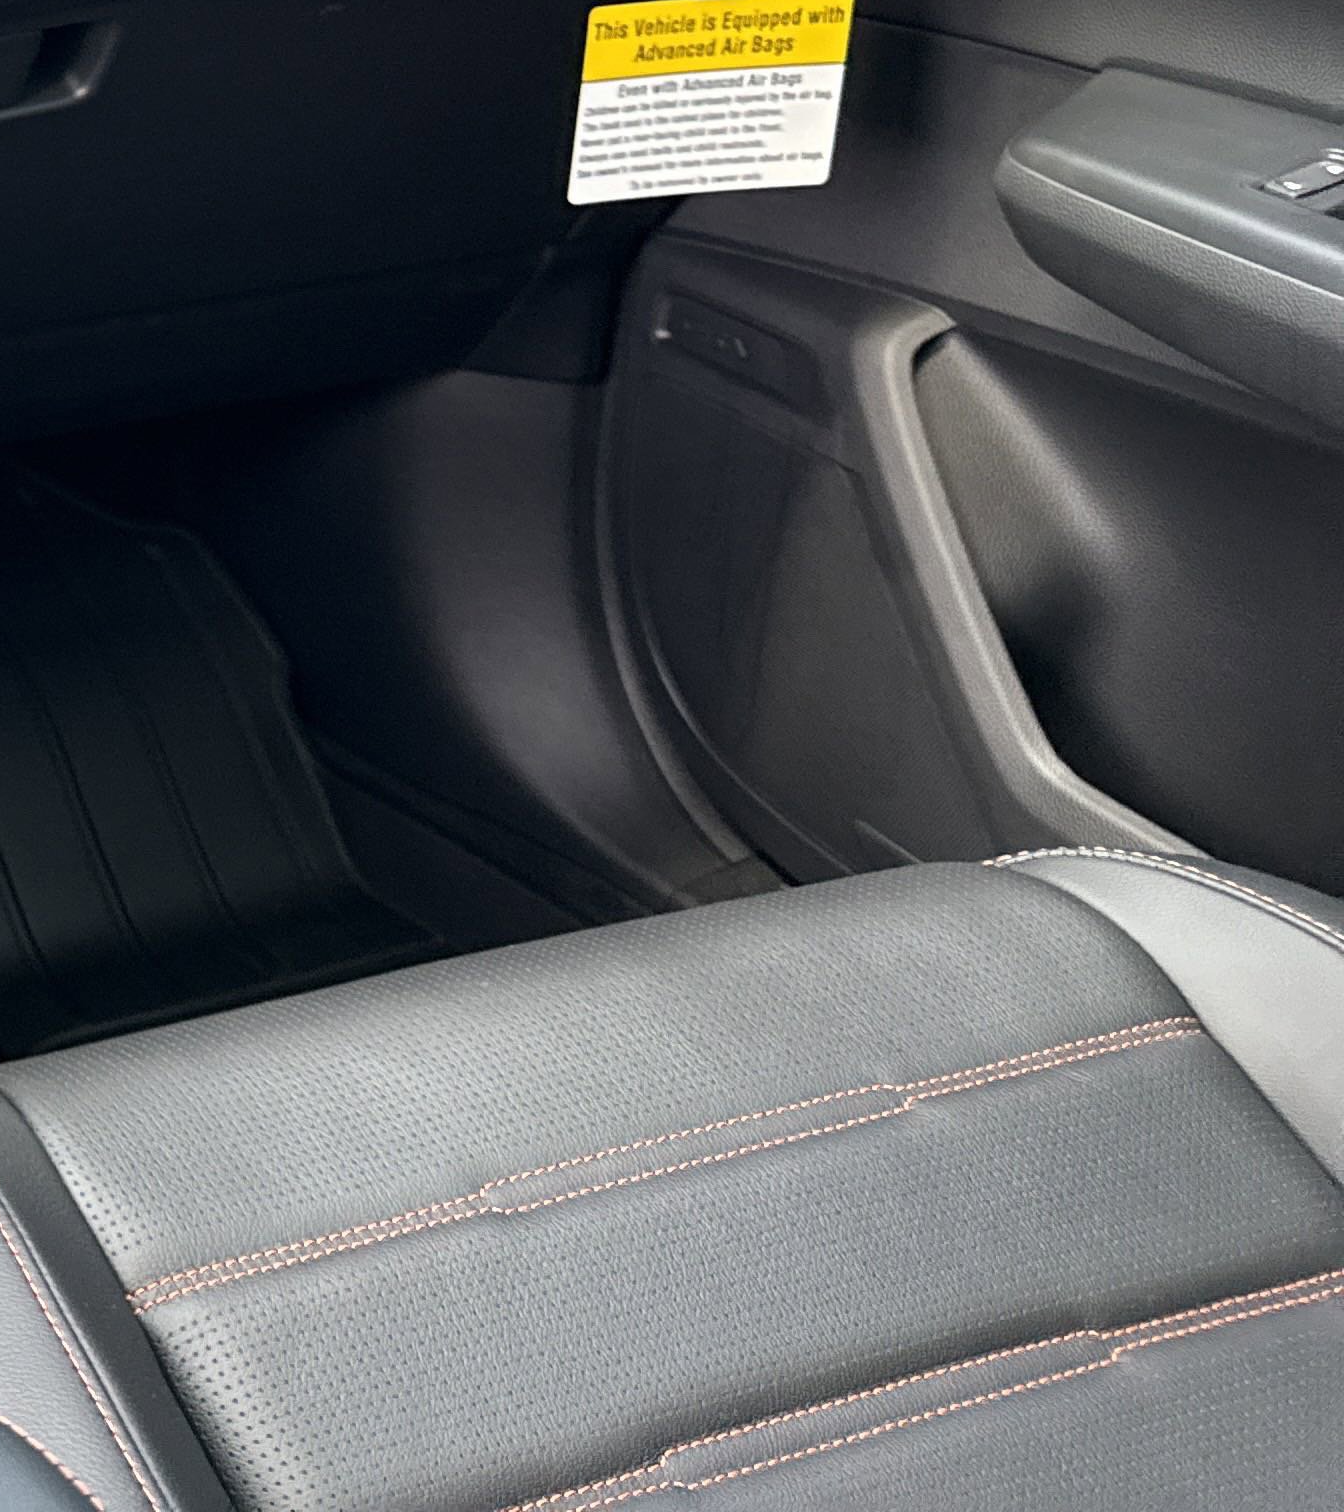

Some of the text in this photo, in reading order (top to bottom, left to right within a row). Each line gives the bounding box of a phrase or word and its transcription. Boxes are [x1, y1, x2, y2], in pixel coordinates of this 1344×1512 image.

[594, 4, 846, 40] This Vehicle is Equipped with
[634, 35, 795, 62] Advanced Air Bags
